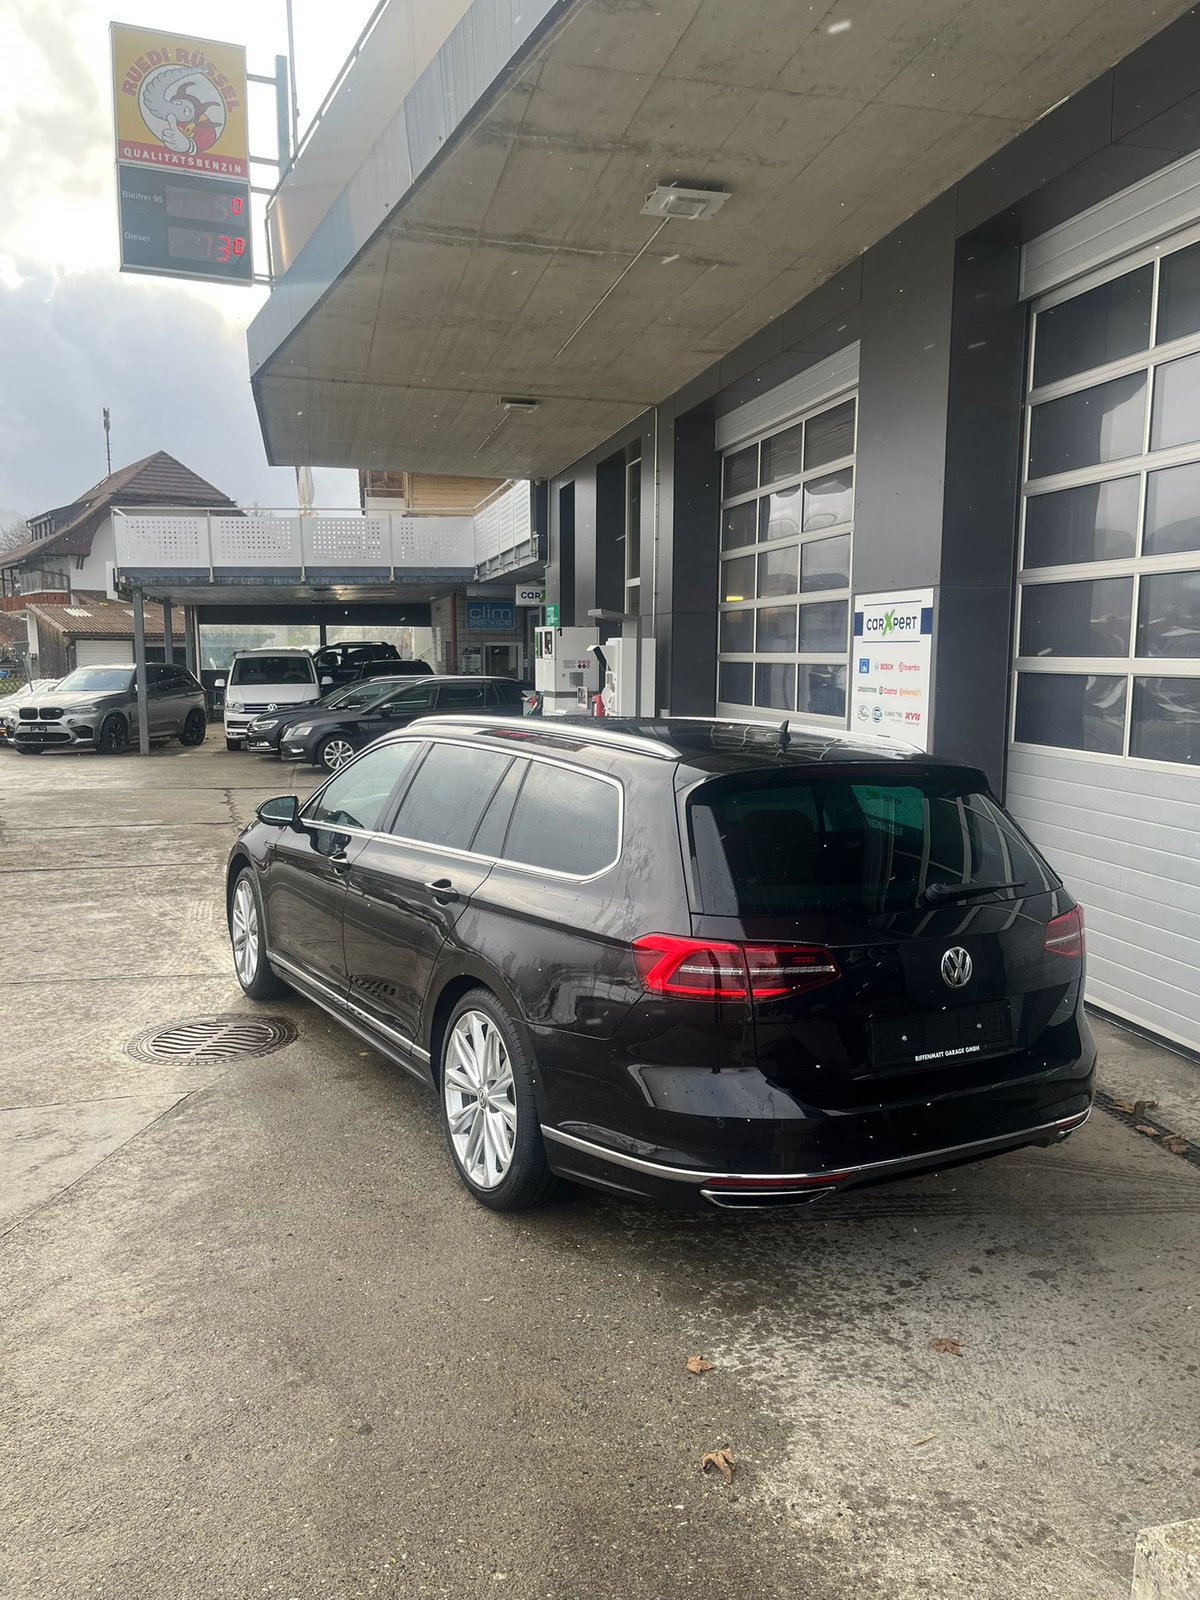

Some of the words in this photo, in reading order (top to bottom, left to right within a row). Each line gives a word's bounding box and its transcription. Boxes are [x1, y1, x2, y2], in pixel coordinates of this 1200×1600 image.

[121, 48, 170, 97] RUEDI
[175, 48, 240, 113] RÜSSEL
[124, 147, 242, 174] QUALITÄTSBENZIN
[122, 190, 151, 202] Bleifrei
[153, 195, 164, 204] 95
[124, 231, 151, 242] Diesel
[469, 604, 512, 619] clim
[469, 618, 512, 626] service
[556, 627, 563, 637] 1
